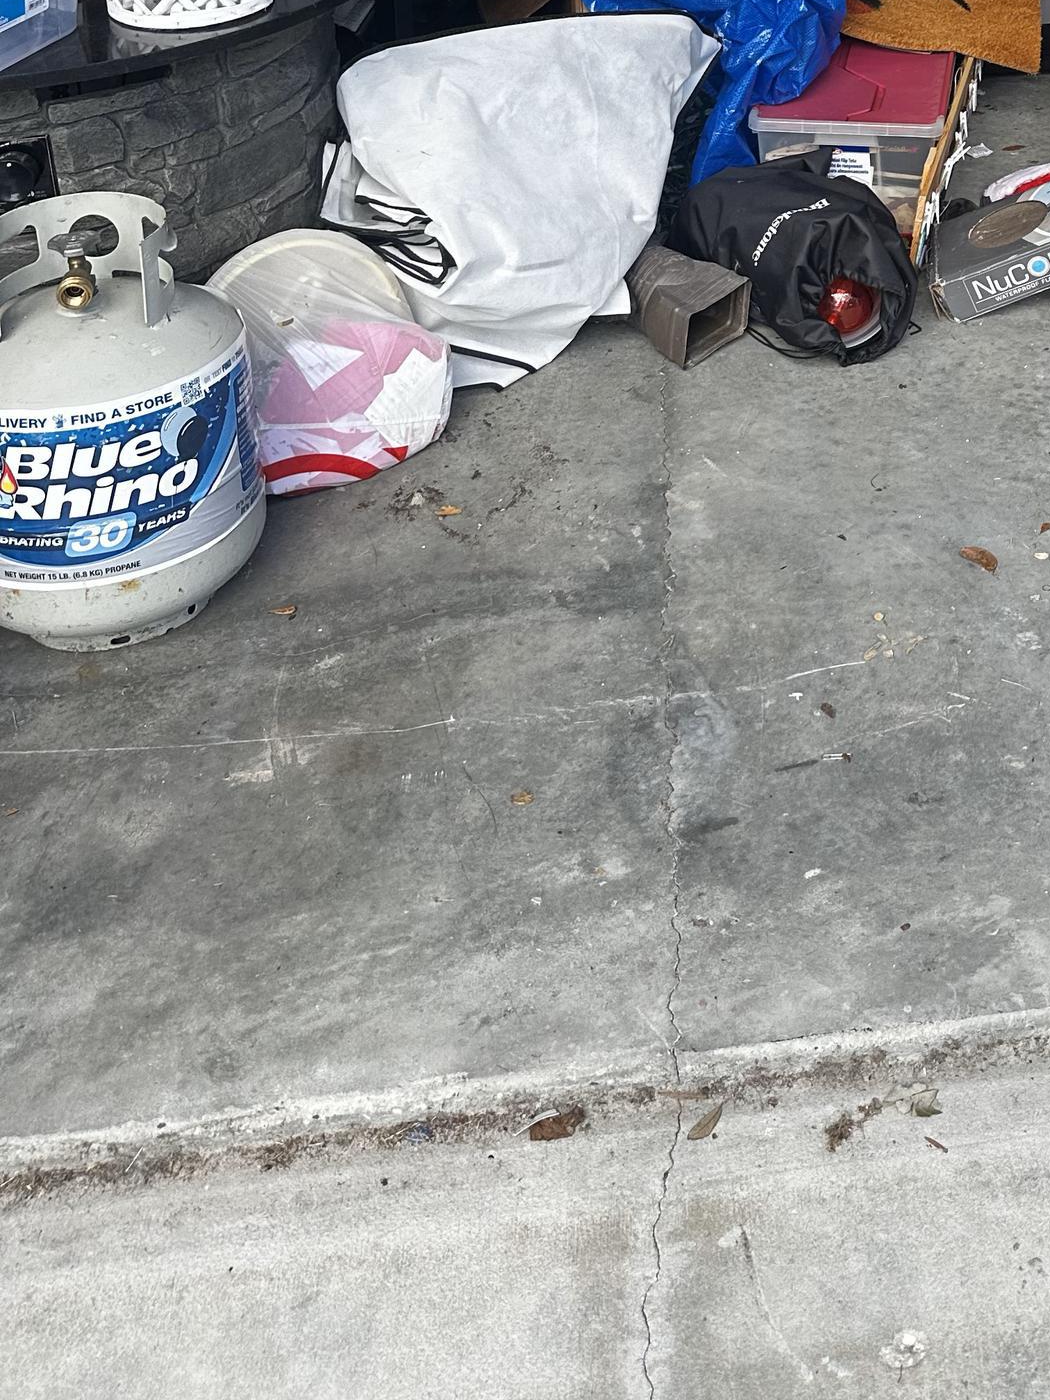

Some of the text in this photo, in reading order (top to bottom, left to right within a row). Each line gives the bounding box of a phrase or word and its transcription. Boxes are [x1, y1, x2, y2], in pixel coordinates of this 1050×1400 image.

[995, 281, 1040, 302] WATERPROOF
[70, 411, 106, 425] FIND
[111, 408, 122, 419] A
[126, 391, 173, 415] STORE
[7, 431, 161, 480] Blue
[0, 458, 199, 520] Rhino
[70, 519, 128, 552] 30
[138, 508, 187, 533] YEARS
[4, 570, 17, 578] NET
[19, 572, 45, 580] WEIGHT
[73, 571, 88, 580] (6.8
[89, 568, 104, 577] KG)
[105, 560, 142, 574] PROPANE
